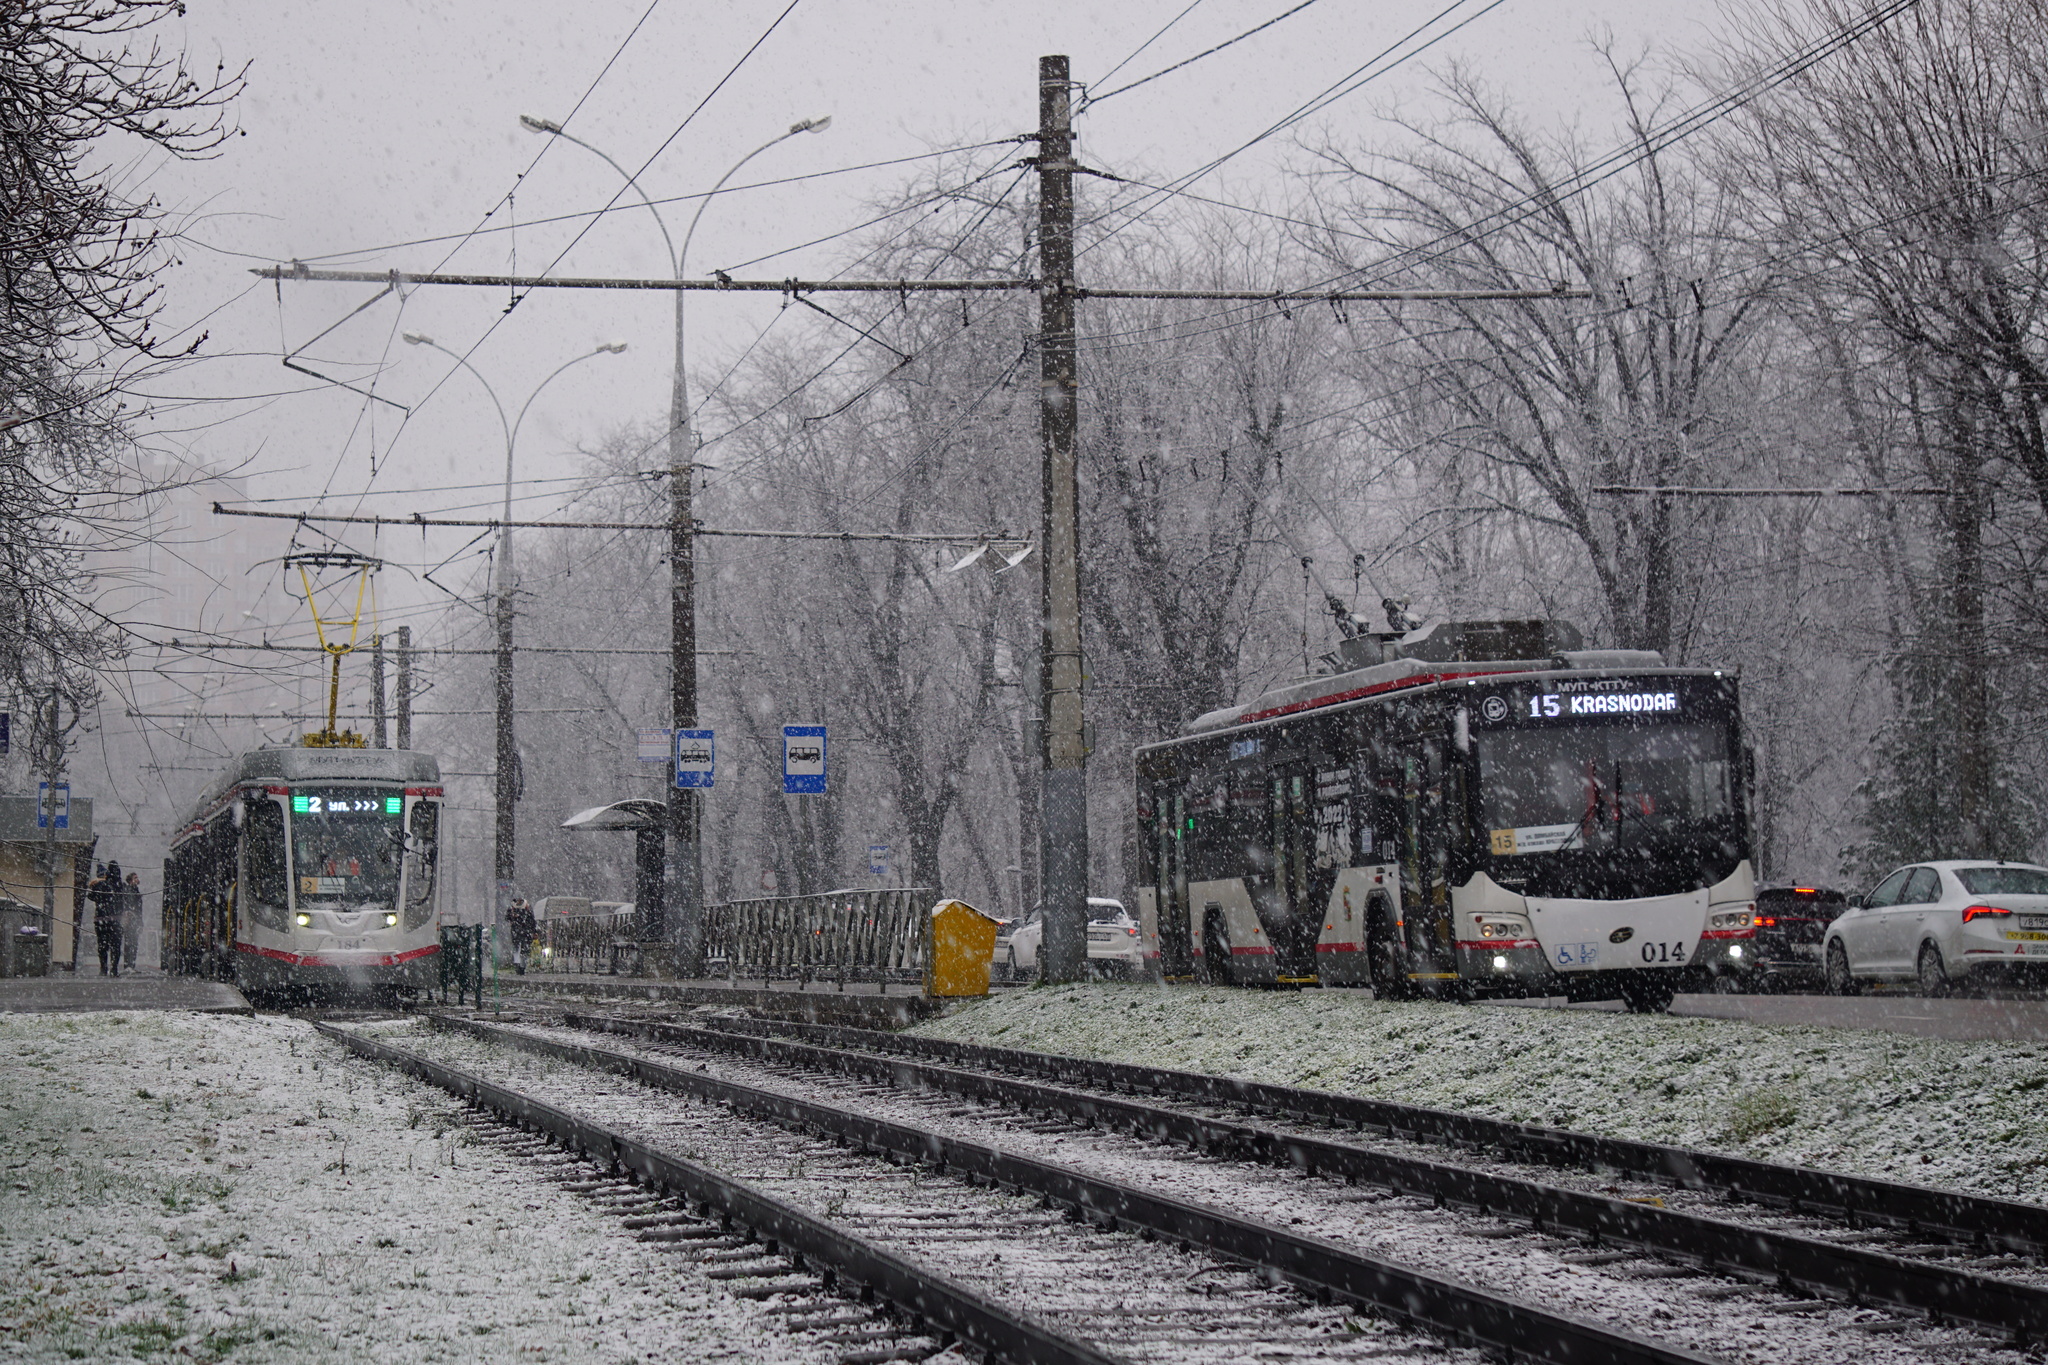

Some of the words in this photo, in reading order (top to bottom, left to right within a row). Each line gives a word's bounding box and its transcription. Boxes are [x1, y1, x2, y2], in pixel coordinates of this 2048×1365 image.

[1557, 681, 1588, 693] МУП
[1529, 694, 1560, 717] 15
[1571, 692, 1676, 713] KRASNODAR
[308, 796, 322, 813] 2
[1496, 835, 1513, 849] 15
[1382, 840, 1397, 860] 014
[304, 880, 313, 892] 2
[337, 939, 361, 950] 184
[1641, 941, 1686, 963] 014
